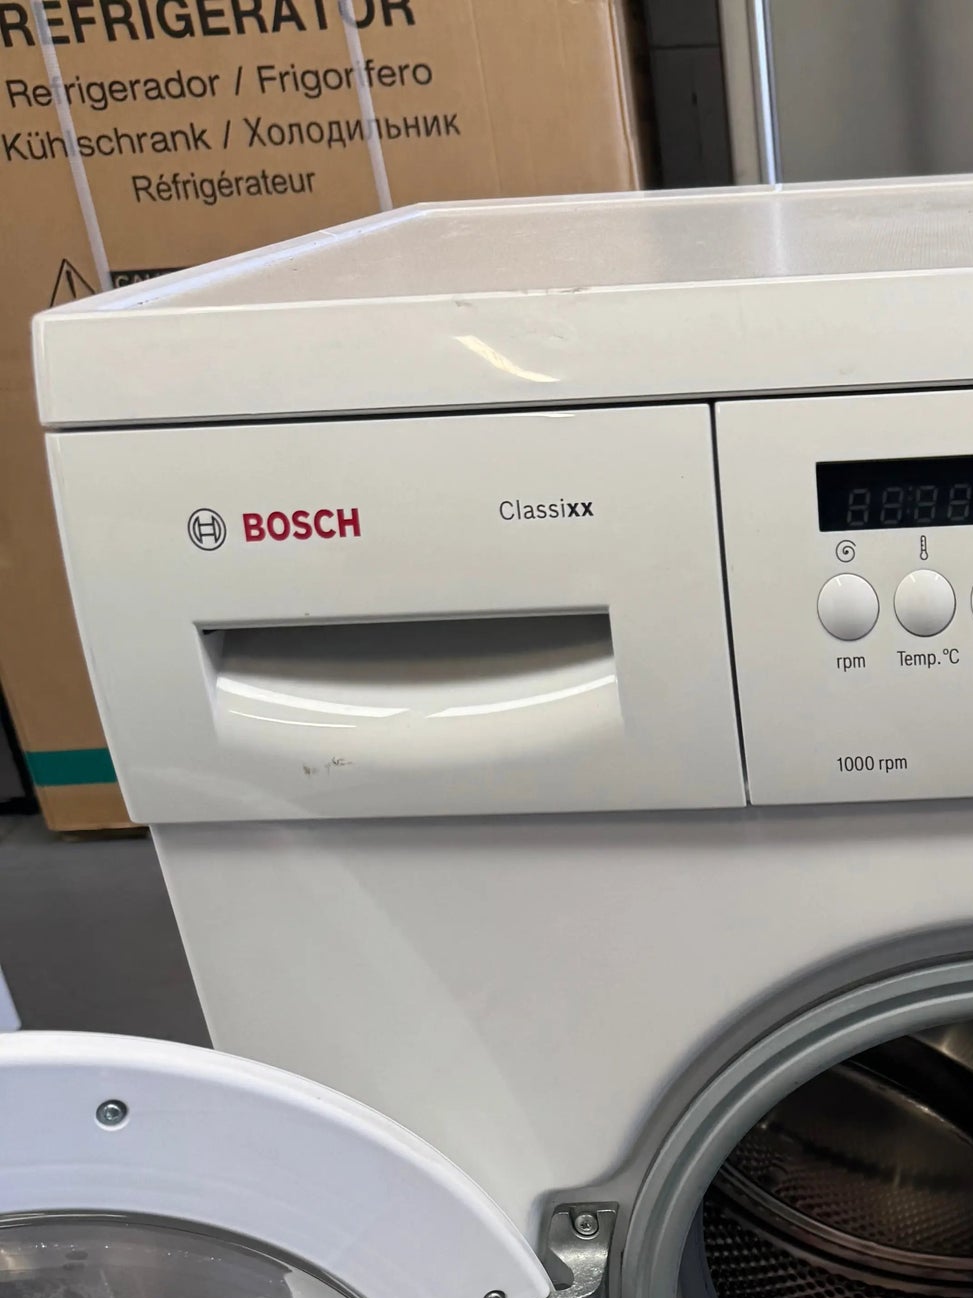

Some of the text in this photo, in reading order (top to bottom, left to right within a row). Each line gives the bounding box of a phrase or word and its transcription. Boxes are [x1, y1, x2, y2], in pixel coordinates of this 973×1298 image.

[235, 66, 242, 96] /
[223, 120, 231, 150] /
[132, 170, 316, 205] Réfrigérateur
[243, 507, 362, 542] BOSCH
[499, 498, 594, 521] Classixx
[836, 653, 866, 673] rpm
[836, 755, 908, 774] 1000 rpm
